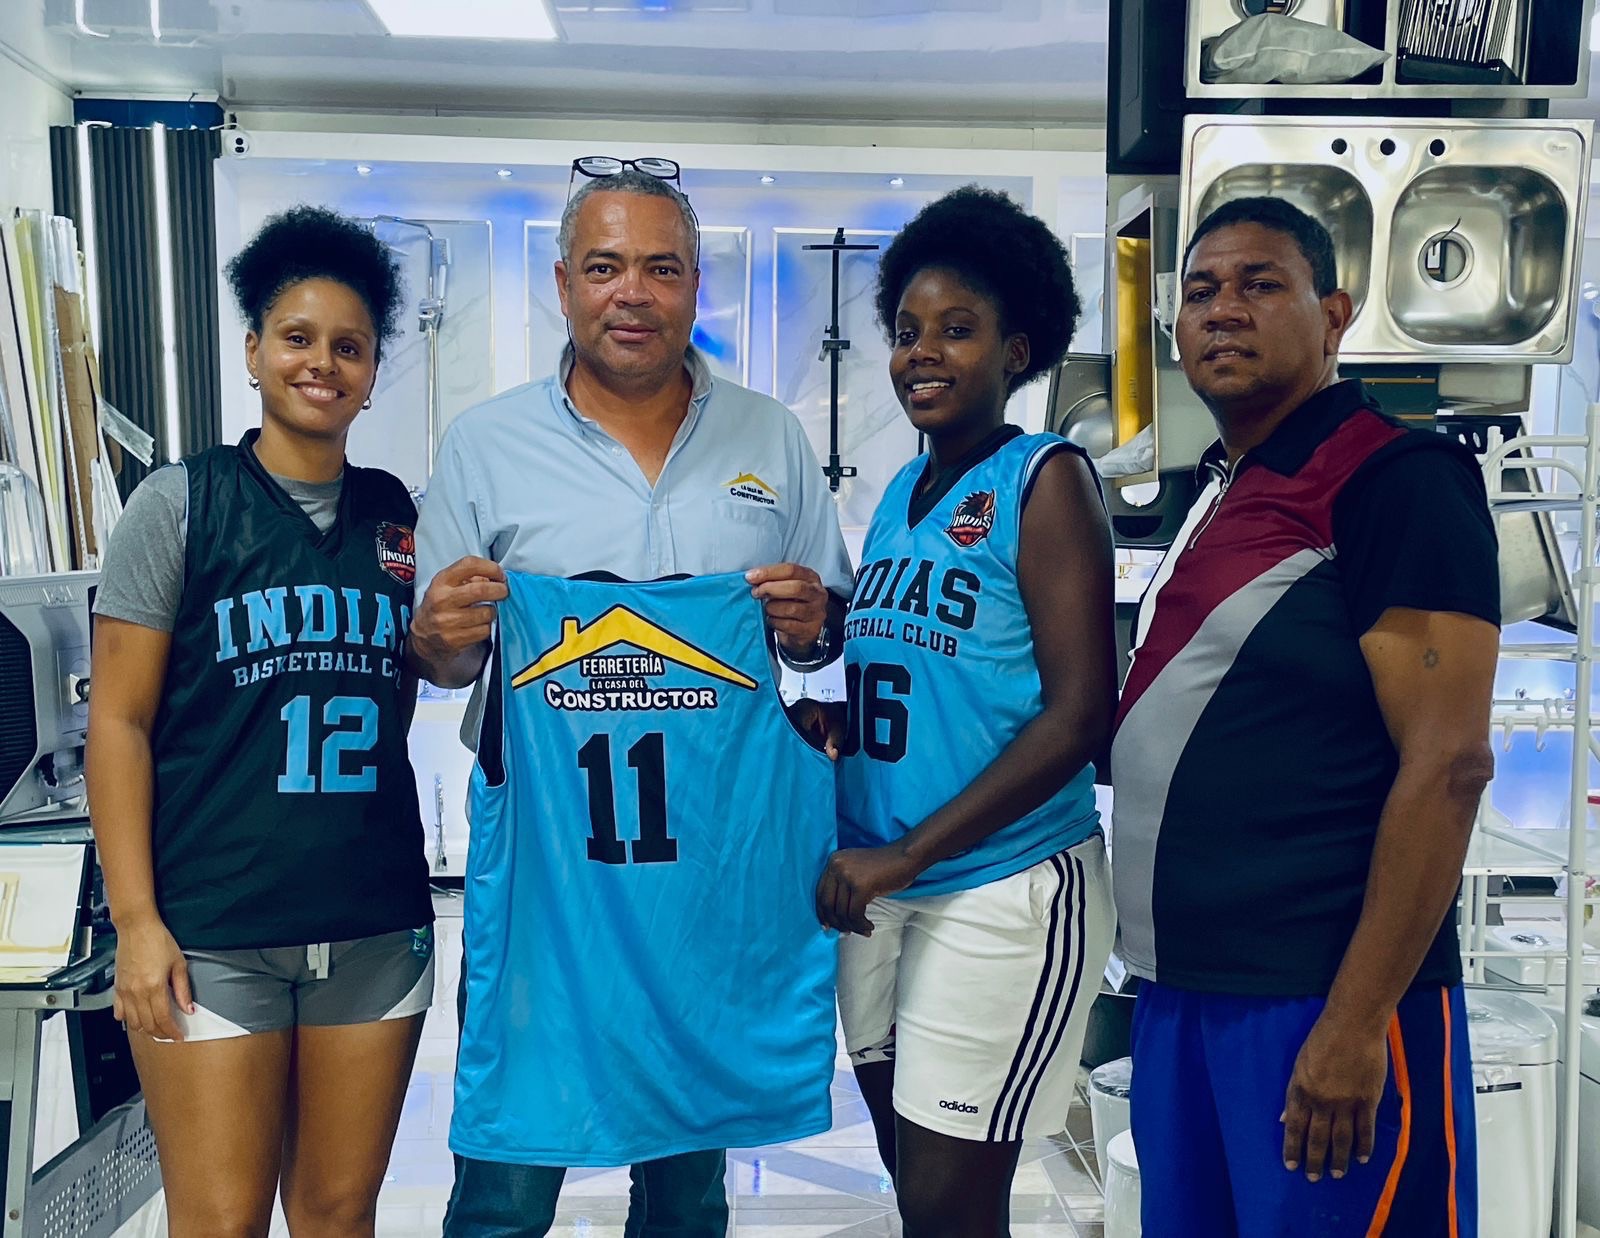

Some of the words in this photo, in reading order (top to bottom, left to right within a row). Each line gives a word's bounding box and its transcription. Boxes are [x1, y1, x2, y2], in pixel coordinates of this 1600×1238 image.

[382, 549, 416, 567] INDIA
[902, 622, 958, 658] CLUB
[232, 651, 373, 688] BASKETBALL
[582, 654, 663, 675] FERRETERÍA
[546, 683, 715, 709] CONSTRUCTOR
[592, 681, 603, 690] LA
[604, 680, 627, 690] CASA
[629, 679, 644, 688] DEL
[277, 695, 379, 793] 12
[577, 732, 678, 865] 11
[939, 1100, 979, 1114] adidas
